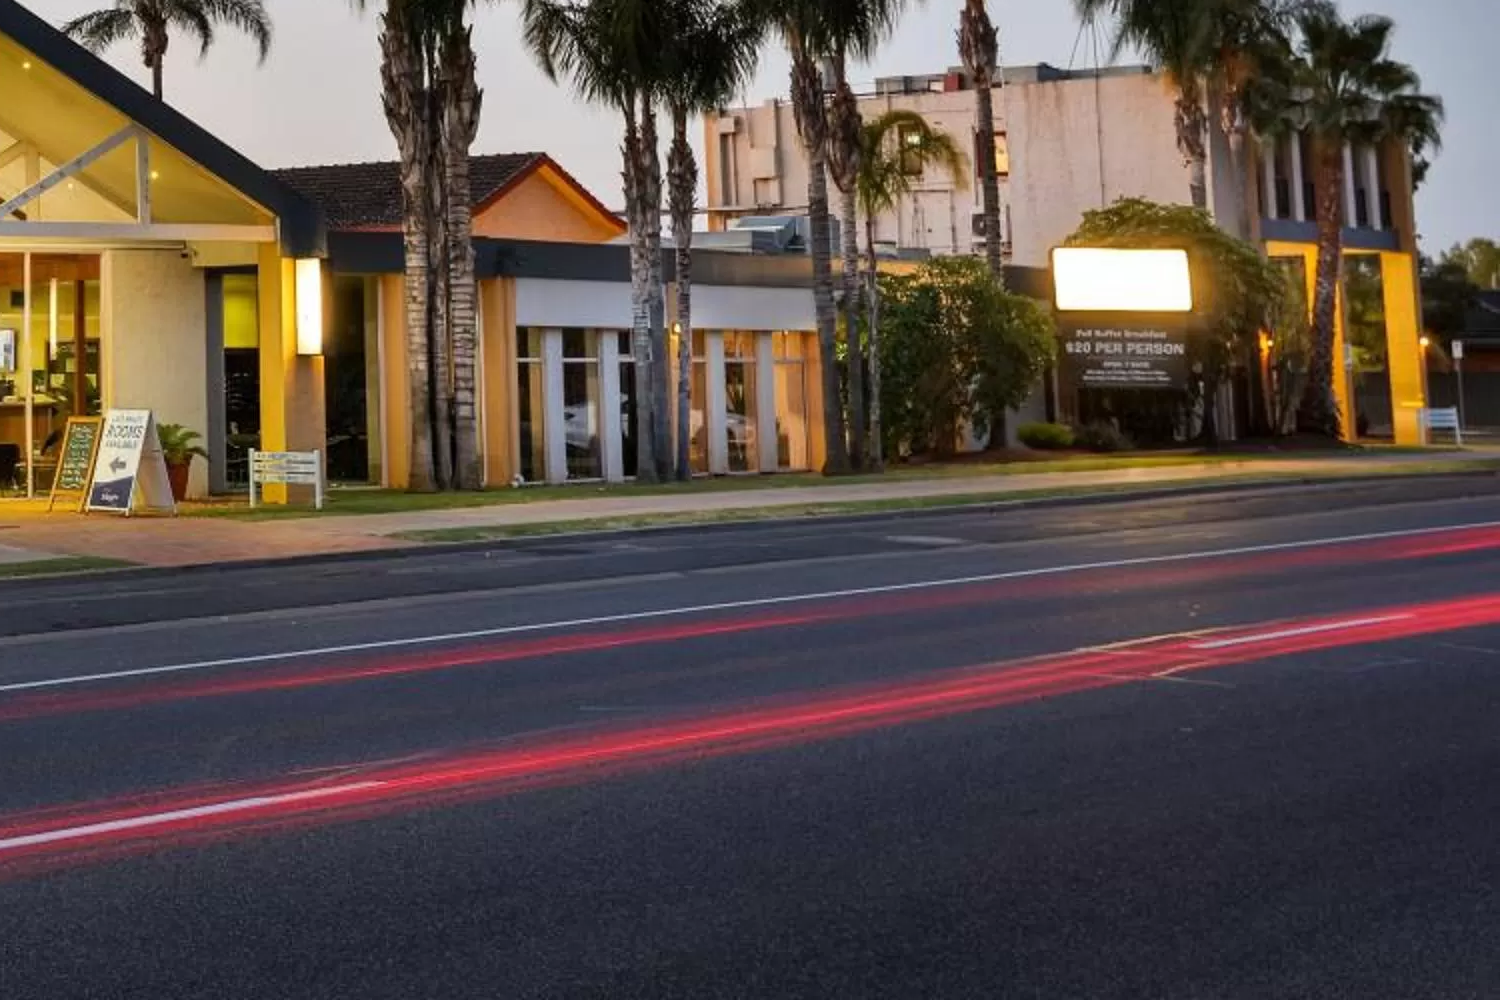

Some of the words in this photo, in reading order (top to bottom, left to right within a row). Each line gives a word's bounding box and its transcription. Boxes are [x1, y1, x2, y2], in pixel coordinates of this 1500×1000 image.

[1095, 342, 1123, 353] PER
[1127, 343, 1185, 355] PERSON
[104, 424, 145, 440] ROOMS
